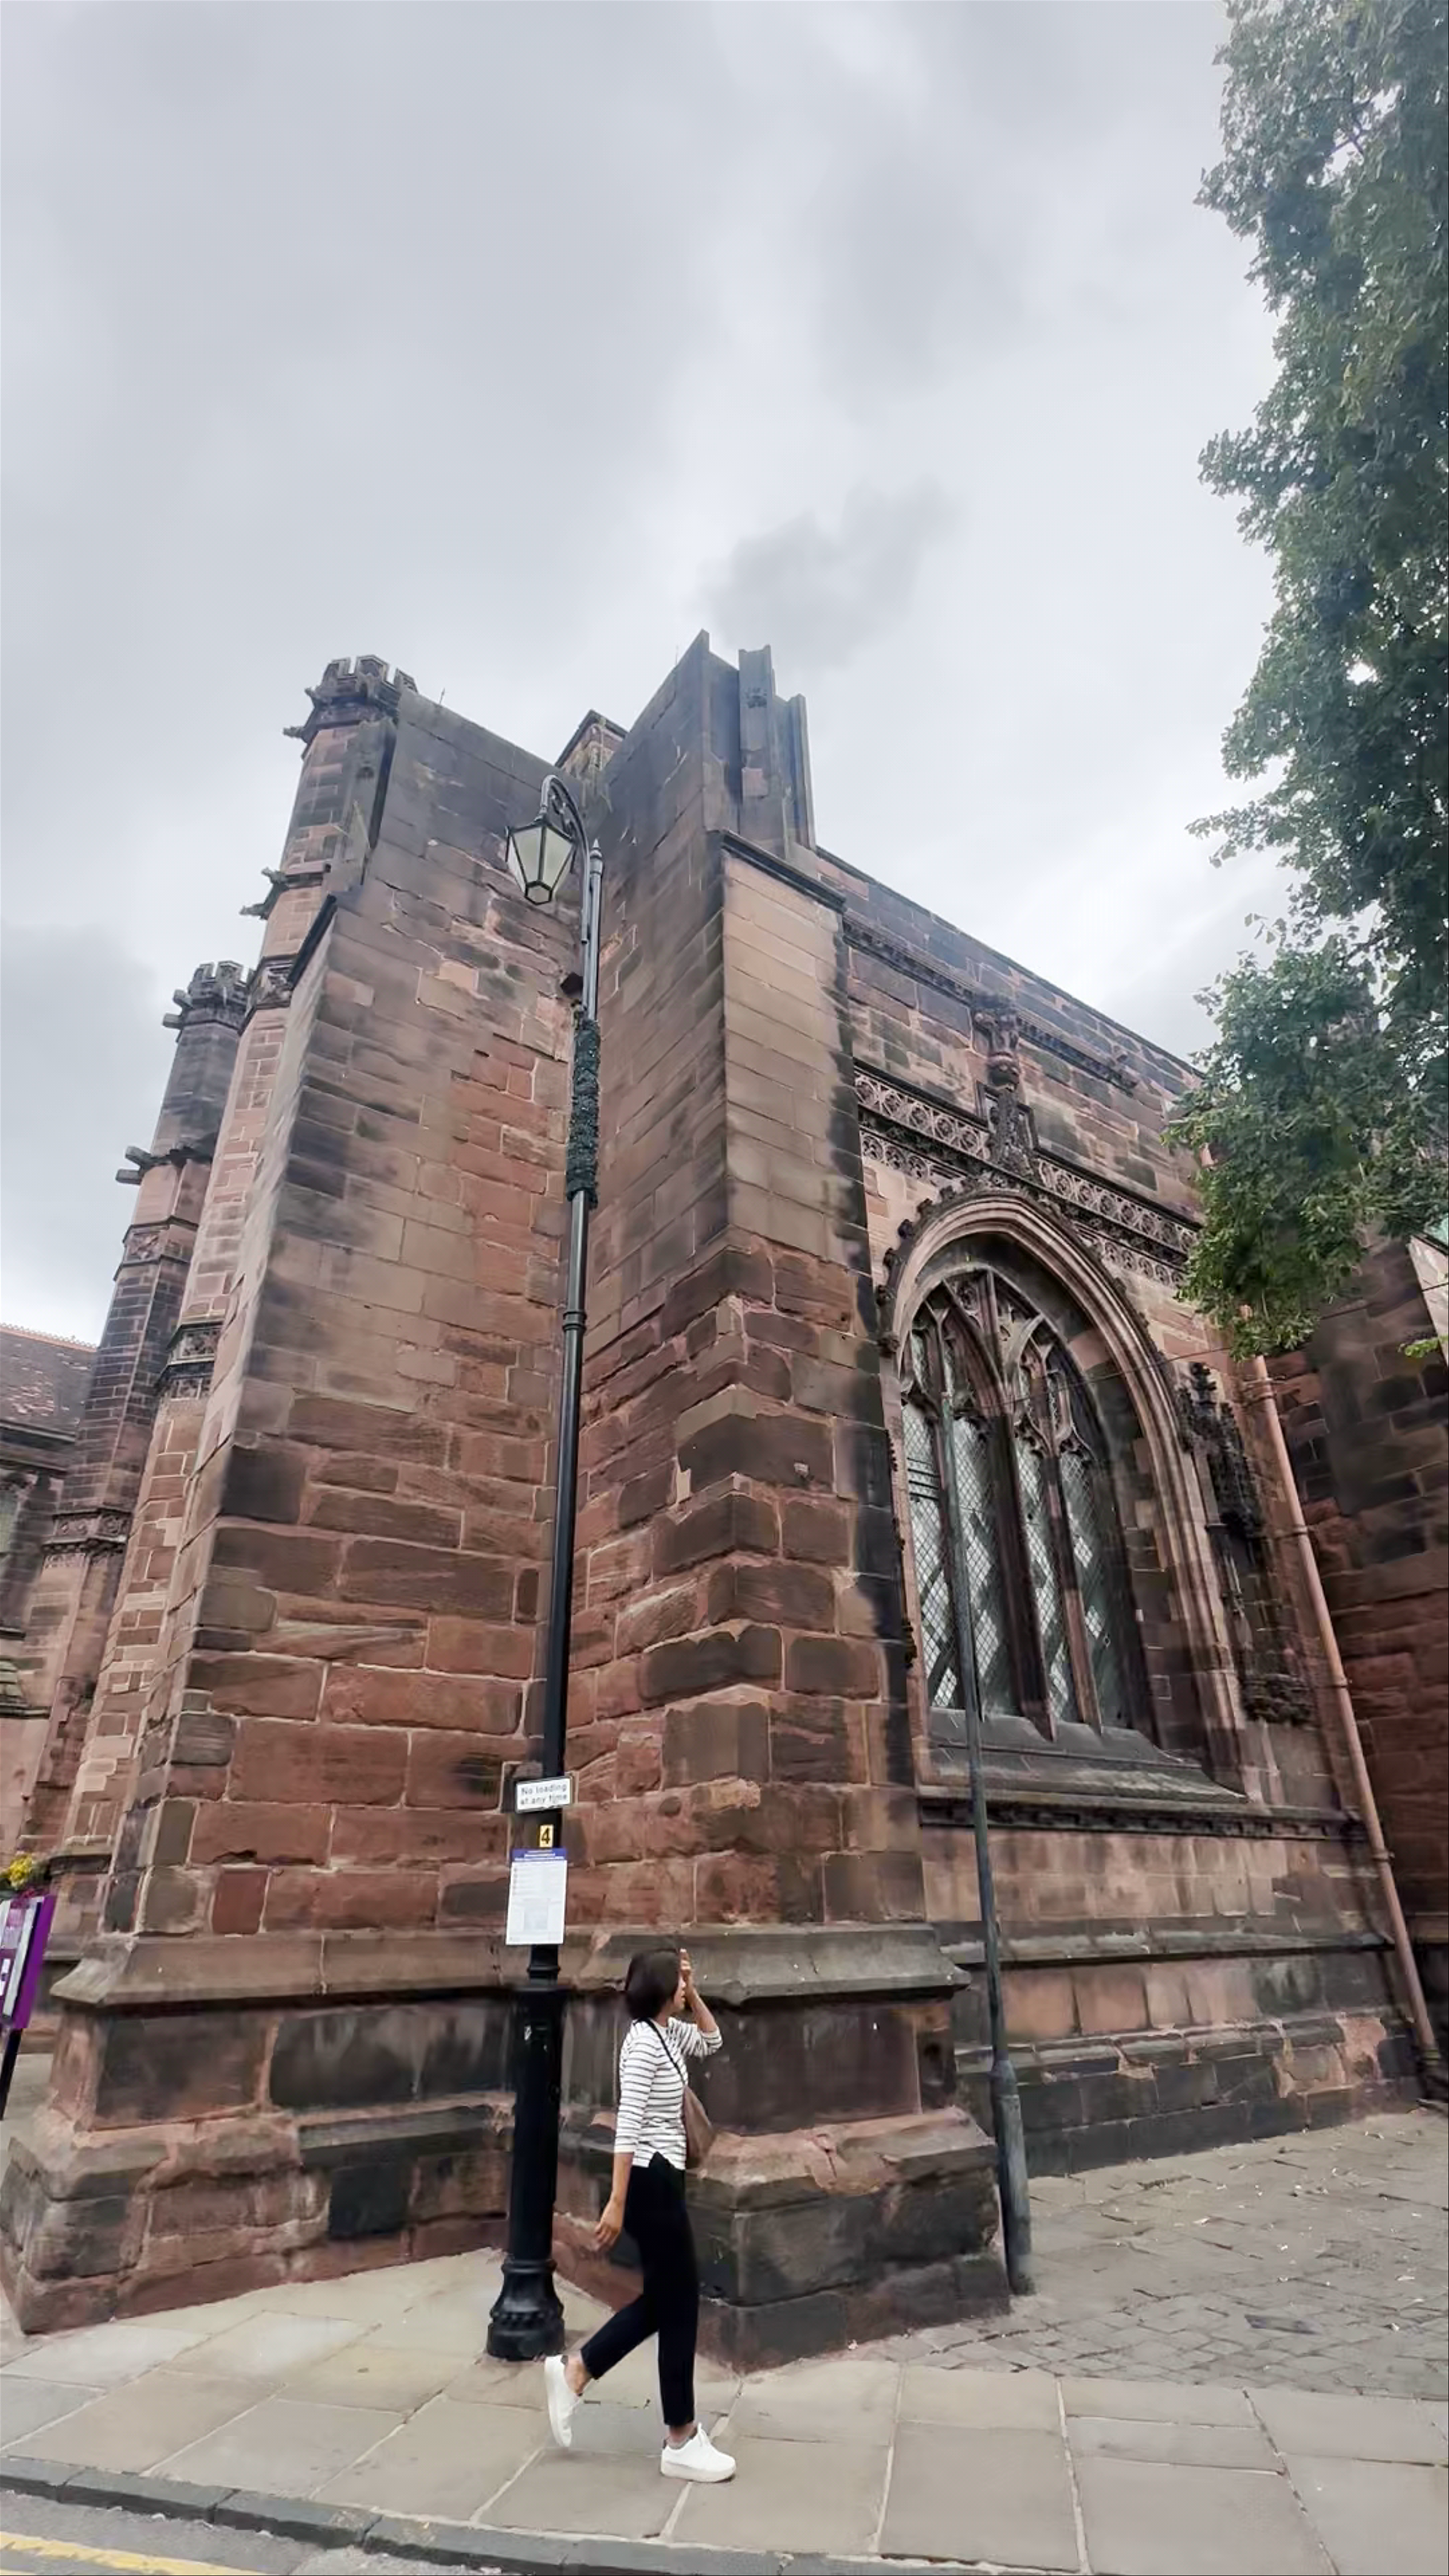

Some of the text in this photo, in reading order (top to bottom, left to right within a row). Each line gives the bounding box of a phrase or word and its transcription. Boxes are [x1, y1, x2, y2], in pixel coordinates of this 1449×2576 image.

[536, 1784, 567, 1793] loading
[549, 1794, 567, 1803] time
[541, 1827, 551, 1844] 4
